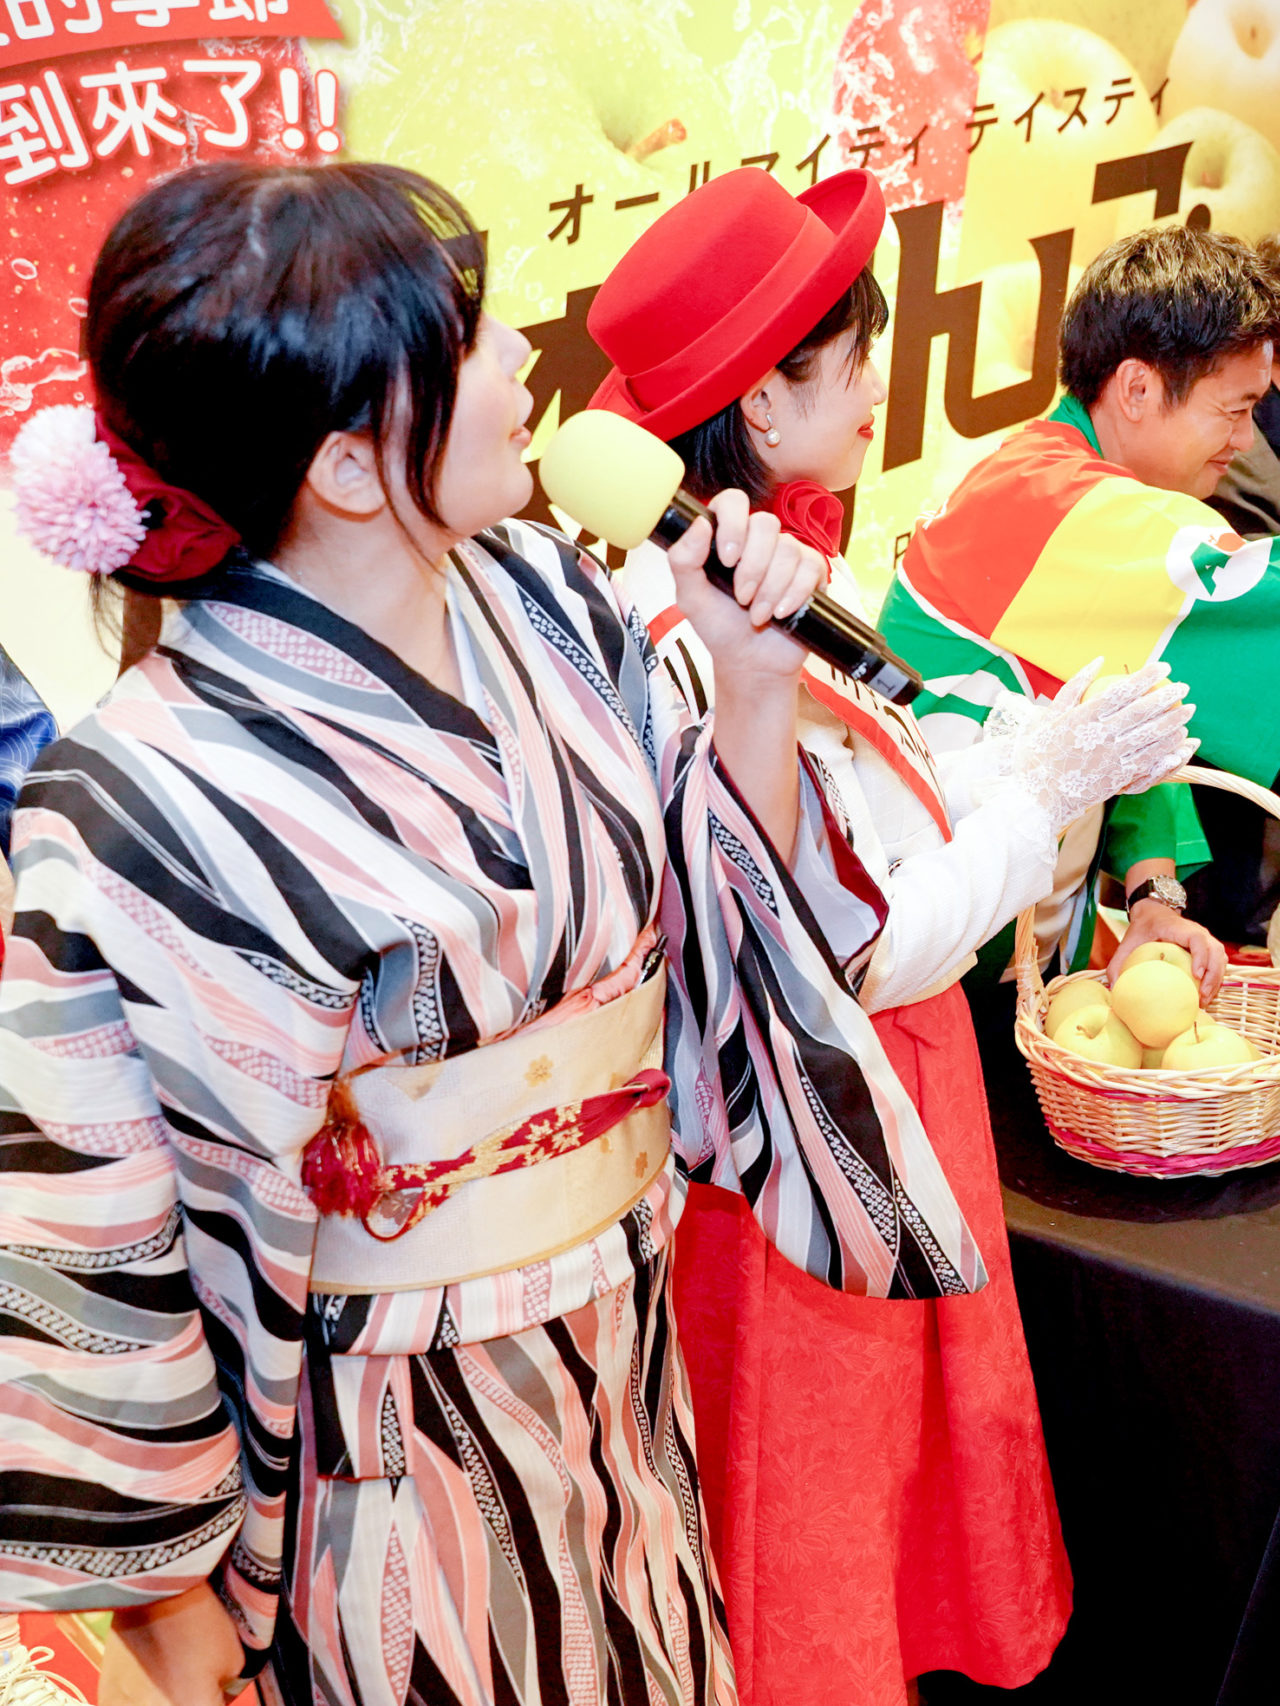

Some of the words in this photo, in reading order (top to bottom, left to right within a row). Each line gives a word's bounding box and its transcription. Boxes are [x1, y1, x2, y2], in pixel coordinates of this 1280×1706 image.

[0, 60, 340, 185] 到來了!!
[964, 77, 1170, 155] テイスティ
